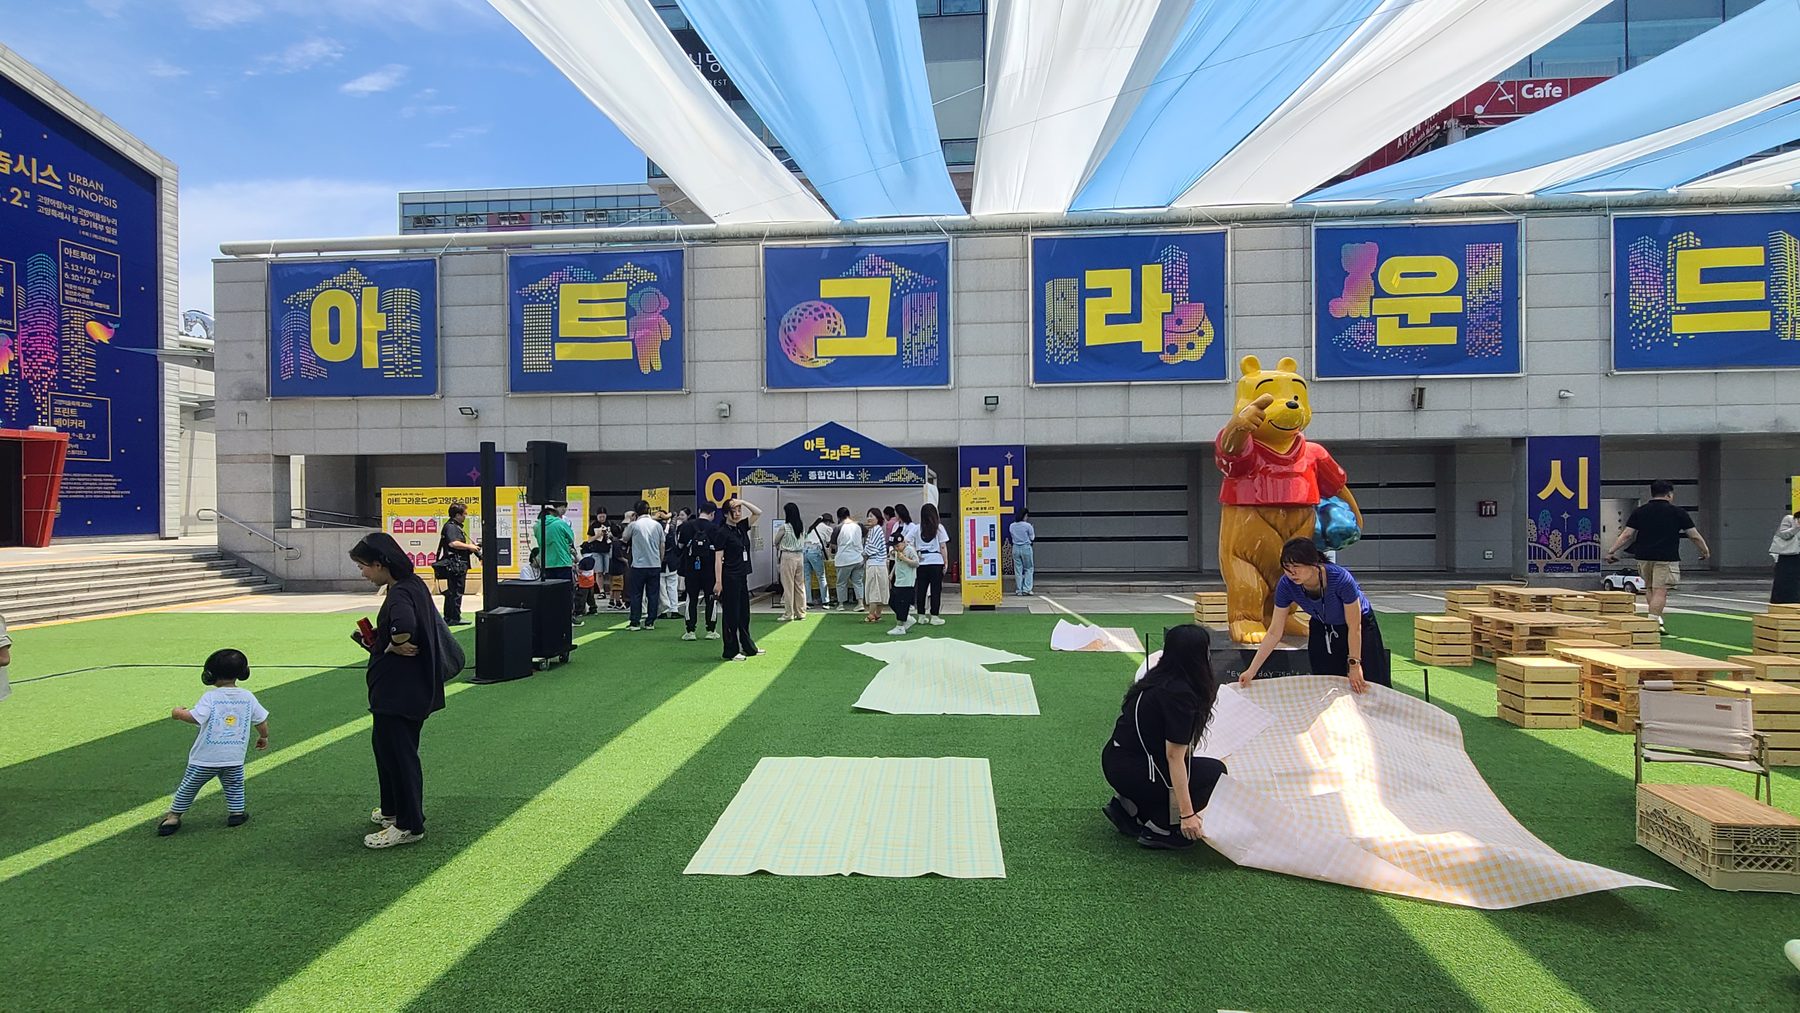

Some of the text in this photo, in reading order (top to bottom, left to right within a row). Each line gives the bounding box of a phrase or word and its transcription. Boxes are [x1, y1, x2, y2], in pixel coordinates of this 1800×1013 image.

[1521, 82, 1563, 99] Cafe
[68, 172, 104, 192] URBAN
[68, 185, 118, 209] SYNOPSIS
[64, 247, 96, 264] 아트투어
[1371, 255, 1463, 347] 운
[1671, 245, 1771, 335] 드
[816, 276, 898, 357] 그
[1084, 263, 1173, 353] 라
[310, 285, 386, 369] 아
[554, 281, 634, 361] 트
[53, 407, 78, 417] 프린트
[53, 417, 86, 429] 베이커리
[804, 437, 826, 451] 아트
[819, 444, 861, 461] 그라운드
[808, 470, 855, 480] 종합안내소
[1537, 456, 1589, 510] 시
[387, 496, 428, 505] 아트그라운드
[970, 465, 1020, 514] 반
